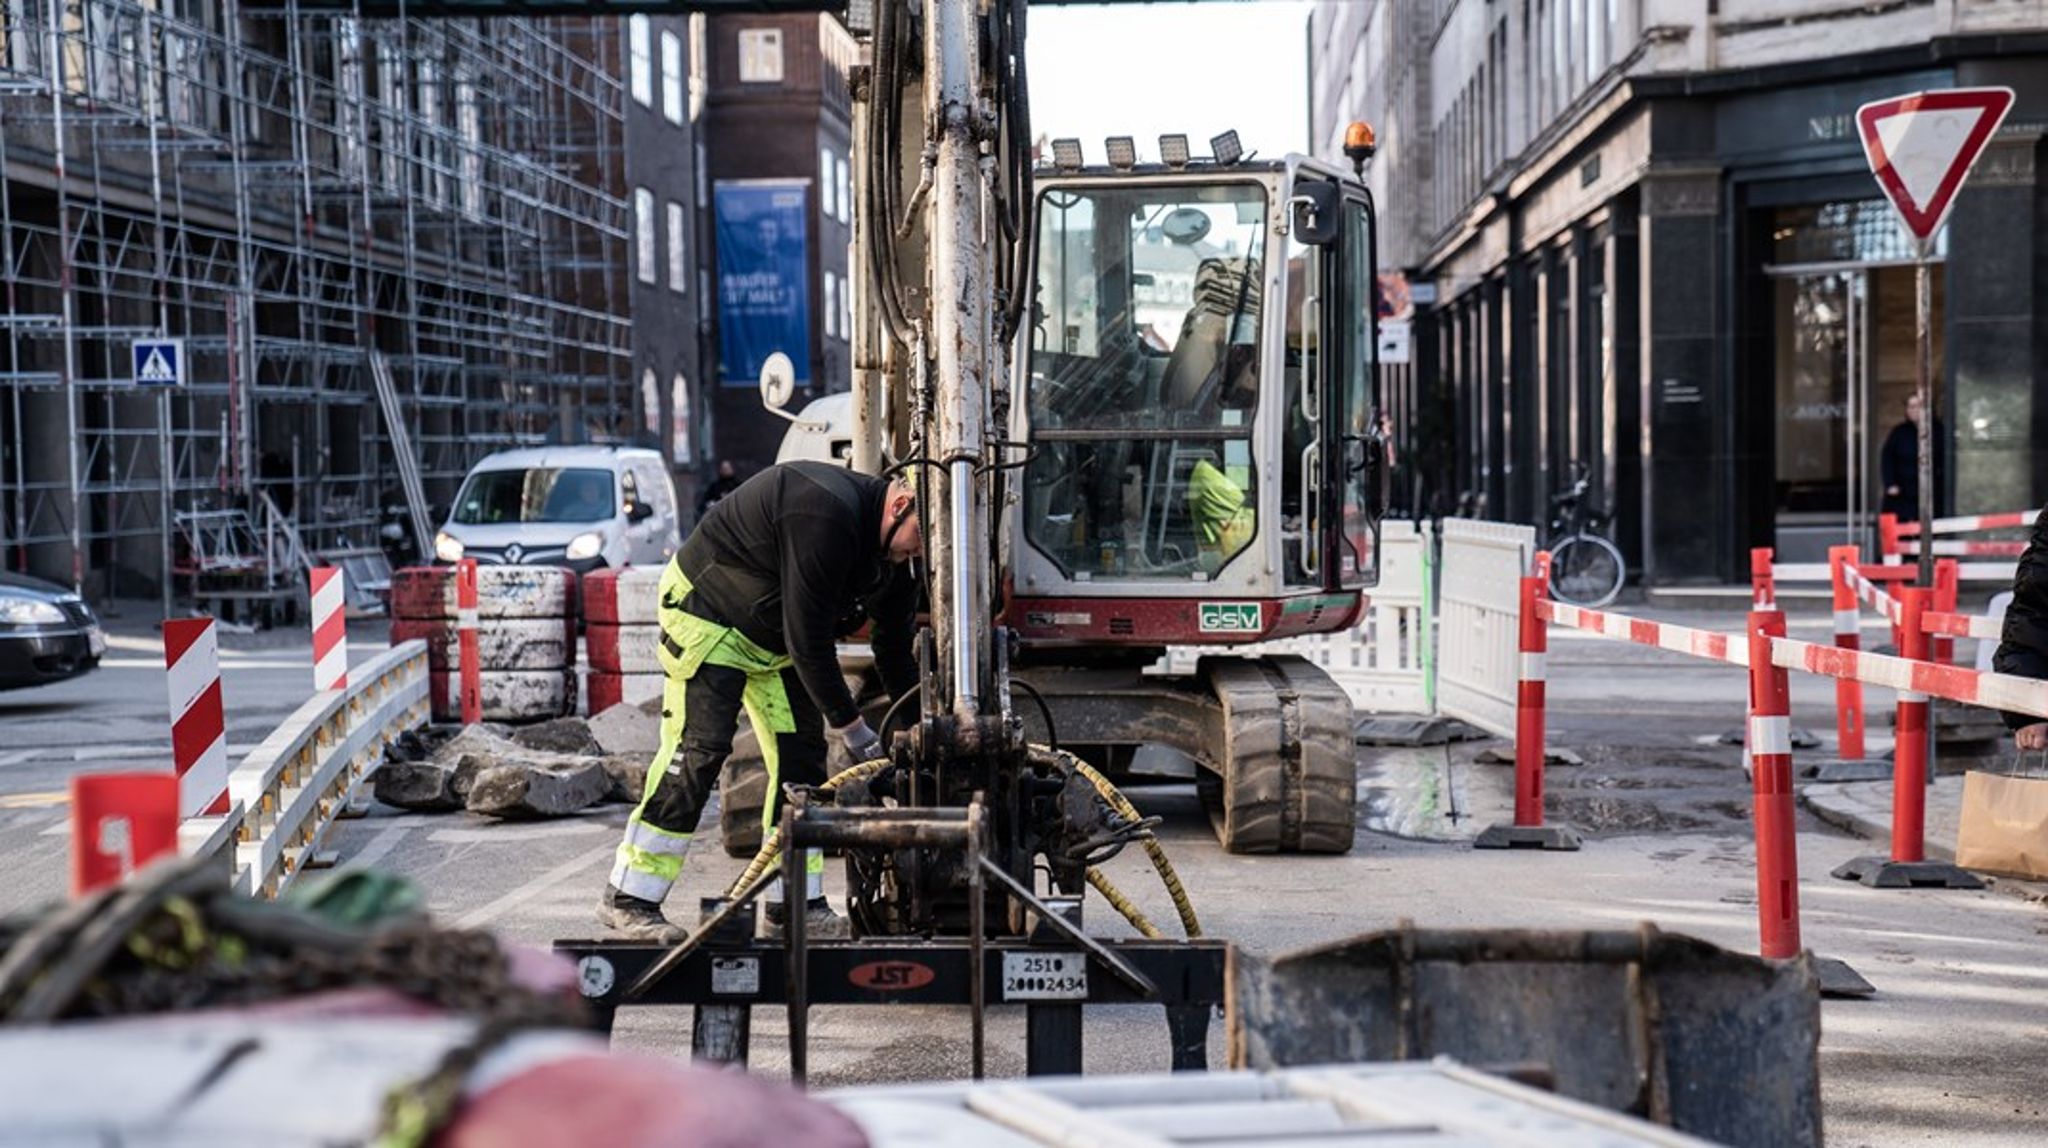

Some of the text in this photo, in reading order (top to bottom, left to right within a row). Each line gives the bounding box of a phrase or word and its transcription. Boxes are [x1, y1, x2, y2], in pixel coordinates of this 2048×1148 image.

[1203, 611, 1258, 629] GSV
[1023, 958, 1064, 973] 2510
[1006, 976, 1085, 992] 20002434
